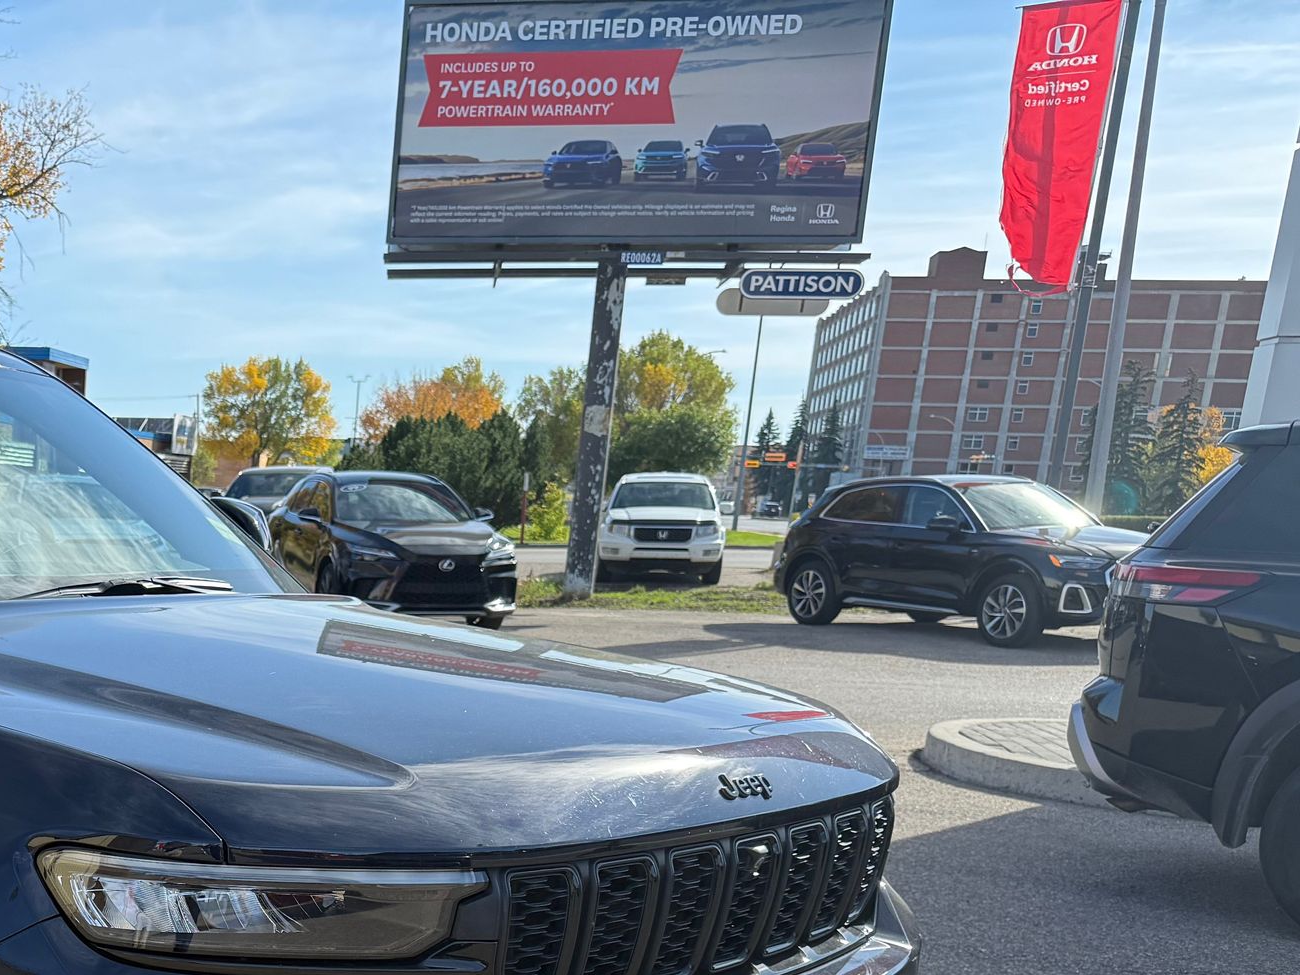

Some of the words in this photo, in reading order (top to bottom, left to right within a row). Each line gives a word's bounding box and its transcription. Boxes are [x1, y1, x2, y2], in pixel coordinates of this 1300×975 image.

[424, 21, 512, 43] HONDA
[518, 17, 643, 41] CERTIFIED
[649, 14, 803, 38] PRE-OWNED
[440, 61, 498, 74] INCLUDES
[501, 61, 517, 73] UP
[518, 60, 534, 72] TO
[438, 76, 618, 99] 7-YEAR/160,000
[625, 76, 659, 96] KM
[437, 104, 528, 118] POWERTRAIN
[770, 205, 797, 214] Regina
[770, 214, 795, 222] Honda
[620, 252, 662, 264] RE00062A
[750, 275, 854, 292] PATTISON
[718, 773, 773, 800] Jeep
